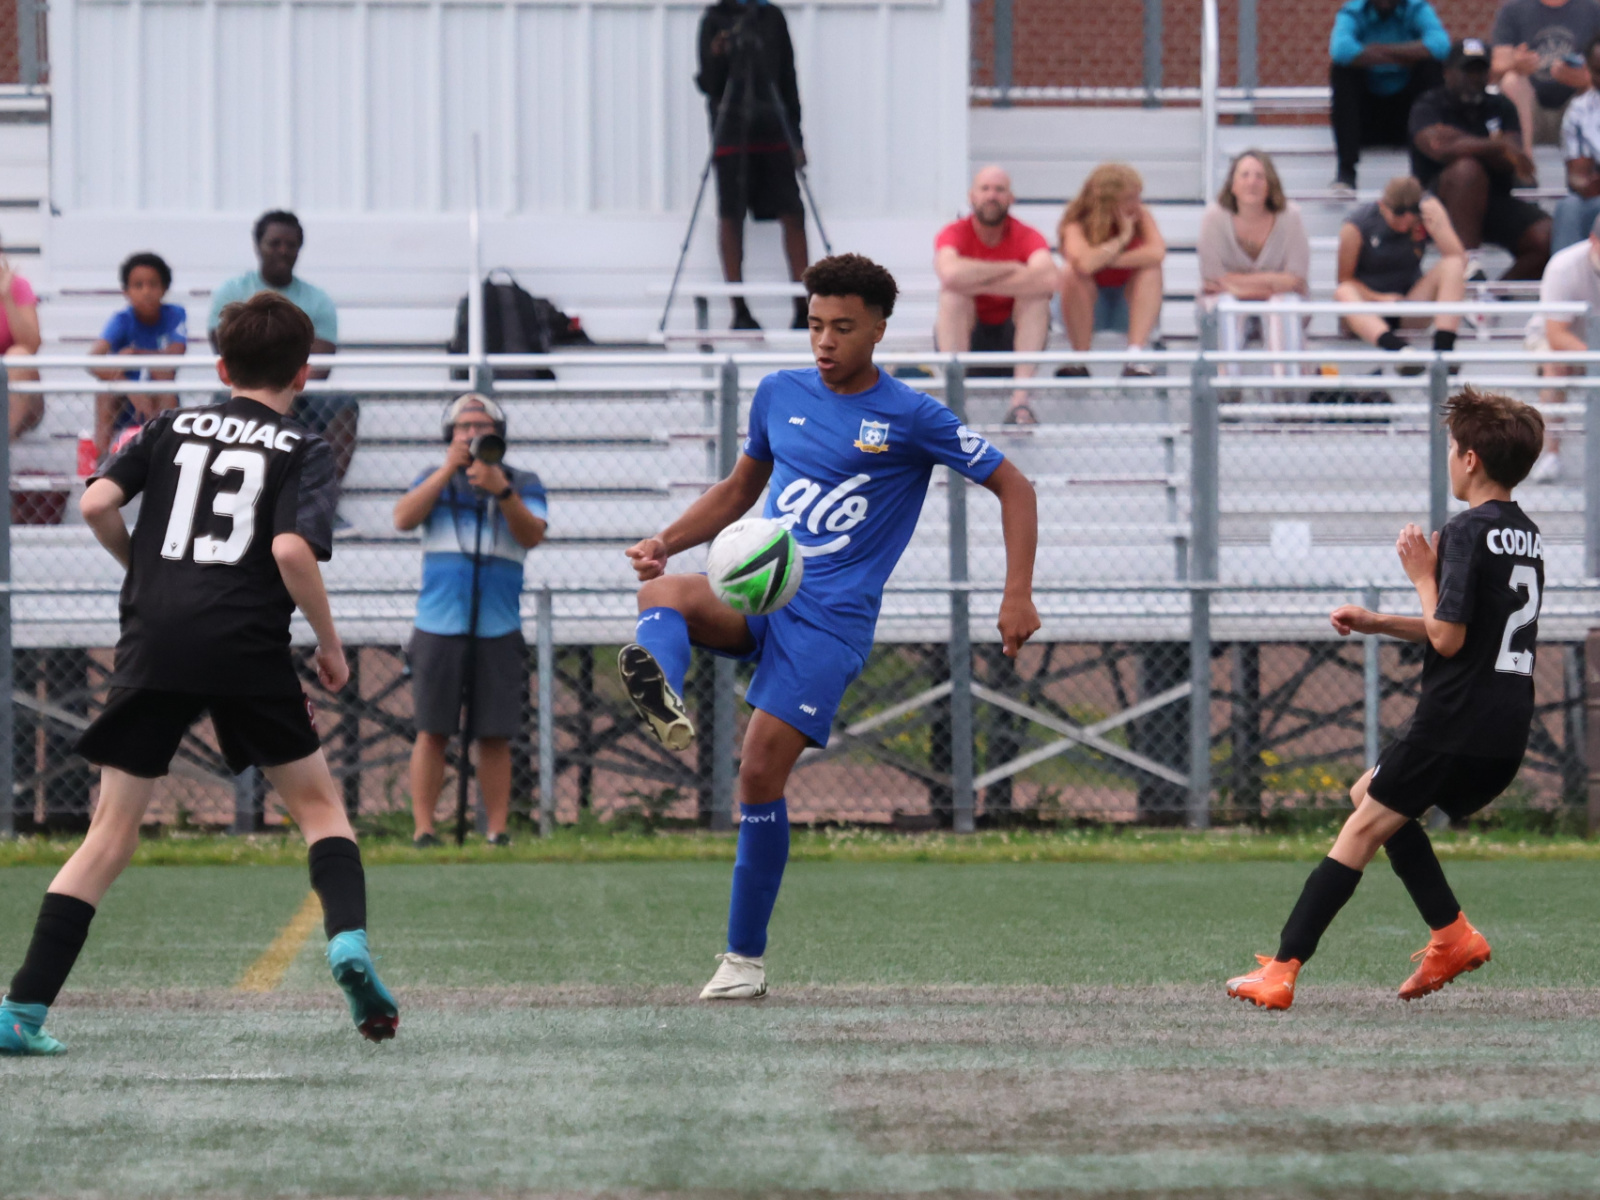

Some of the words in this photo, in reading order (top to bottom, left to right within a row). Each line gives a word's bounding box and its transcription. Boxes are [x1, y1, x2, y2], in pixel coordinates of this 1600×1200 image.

[172, 413, 300, 452] CODIAC
[160, 442, 265, 565] 13
[1486, 527, 1544, 561] CODIA
[1494, 564, 1540, 676] 2
